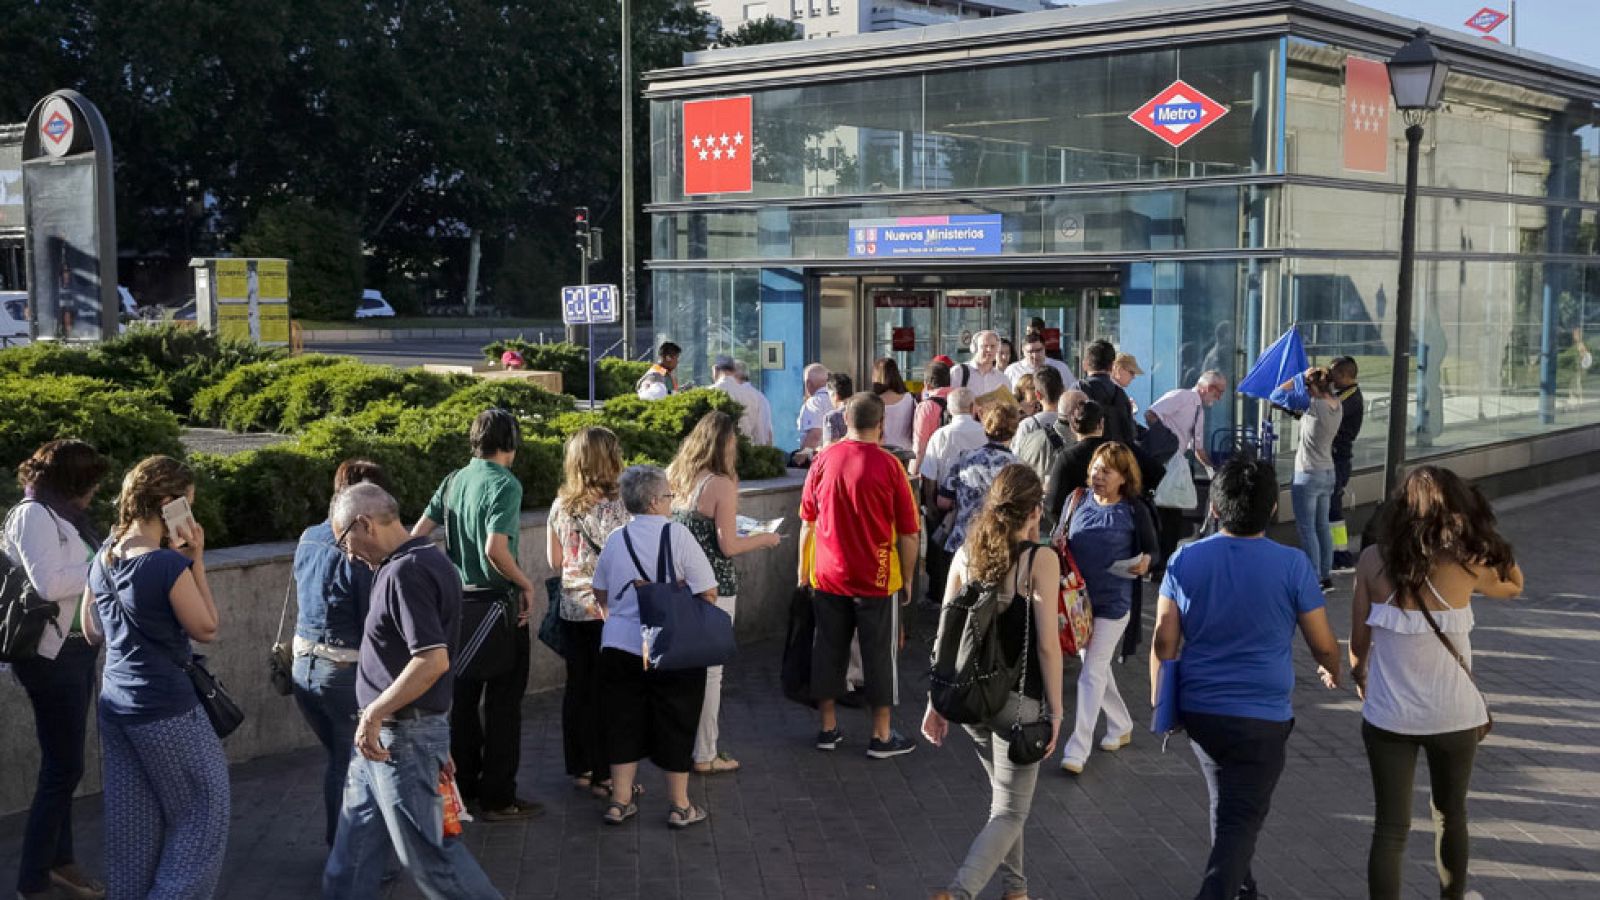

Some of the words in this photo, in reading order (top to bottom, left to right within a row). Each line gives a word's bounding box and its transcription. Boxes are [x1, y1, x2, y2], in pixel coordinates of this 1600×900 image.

[1158, 108, 1197, 121] Metro
[884, 230, 923, 241] Nuevos
[926, 228, 984, 240] Ministerios
[590, 287, 609, 314] 20
